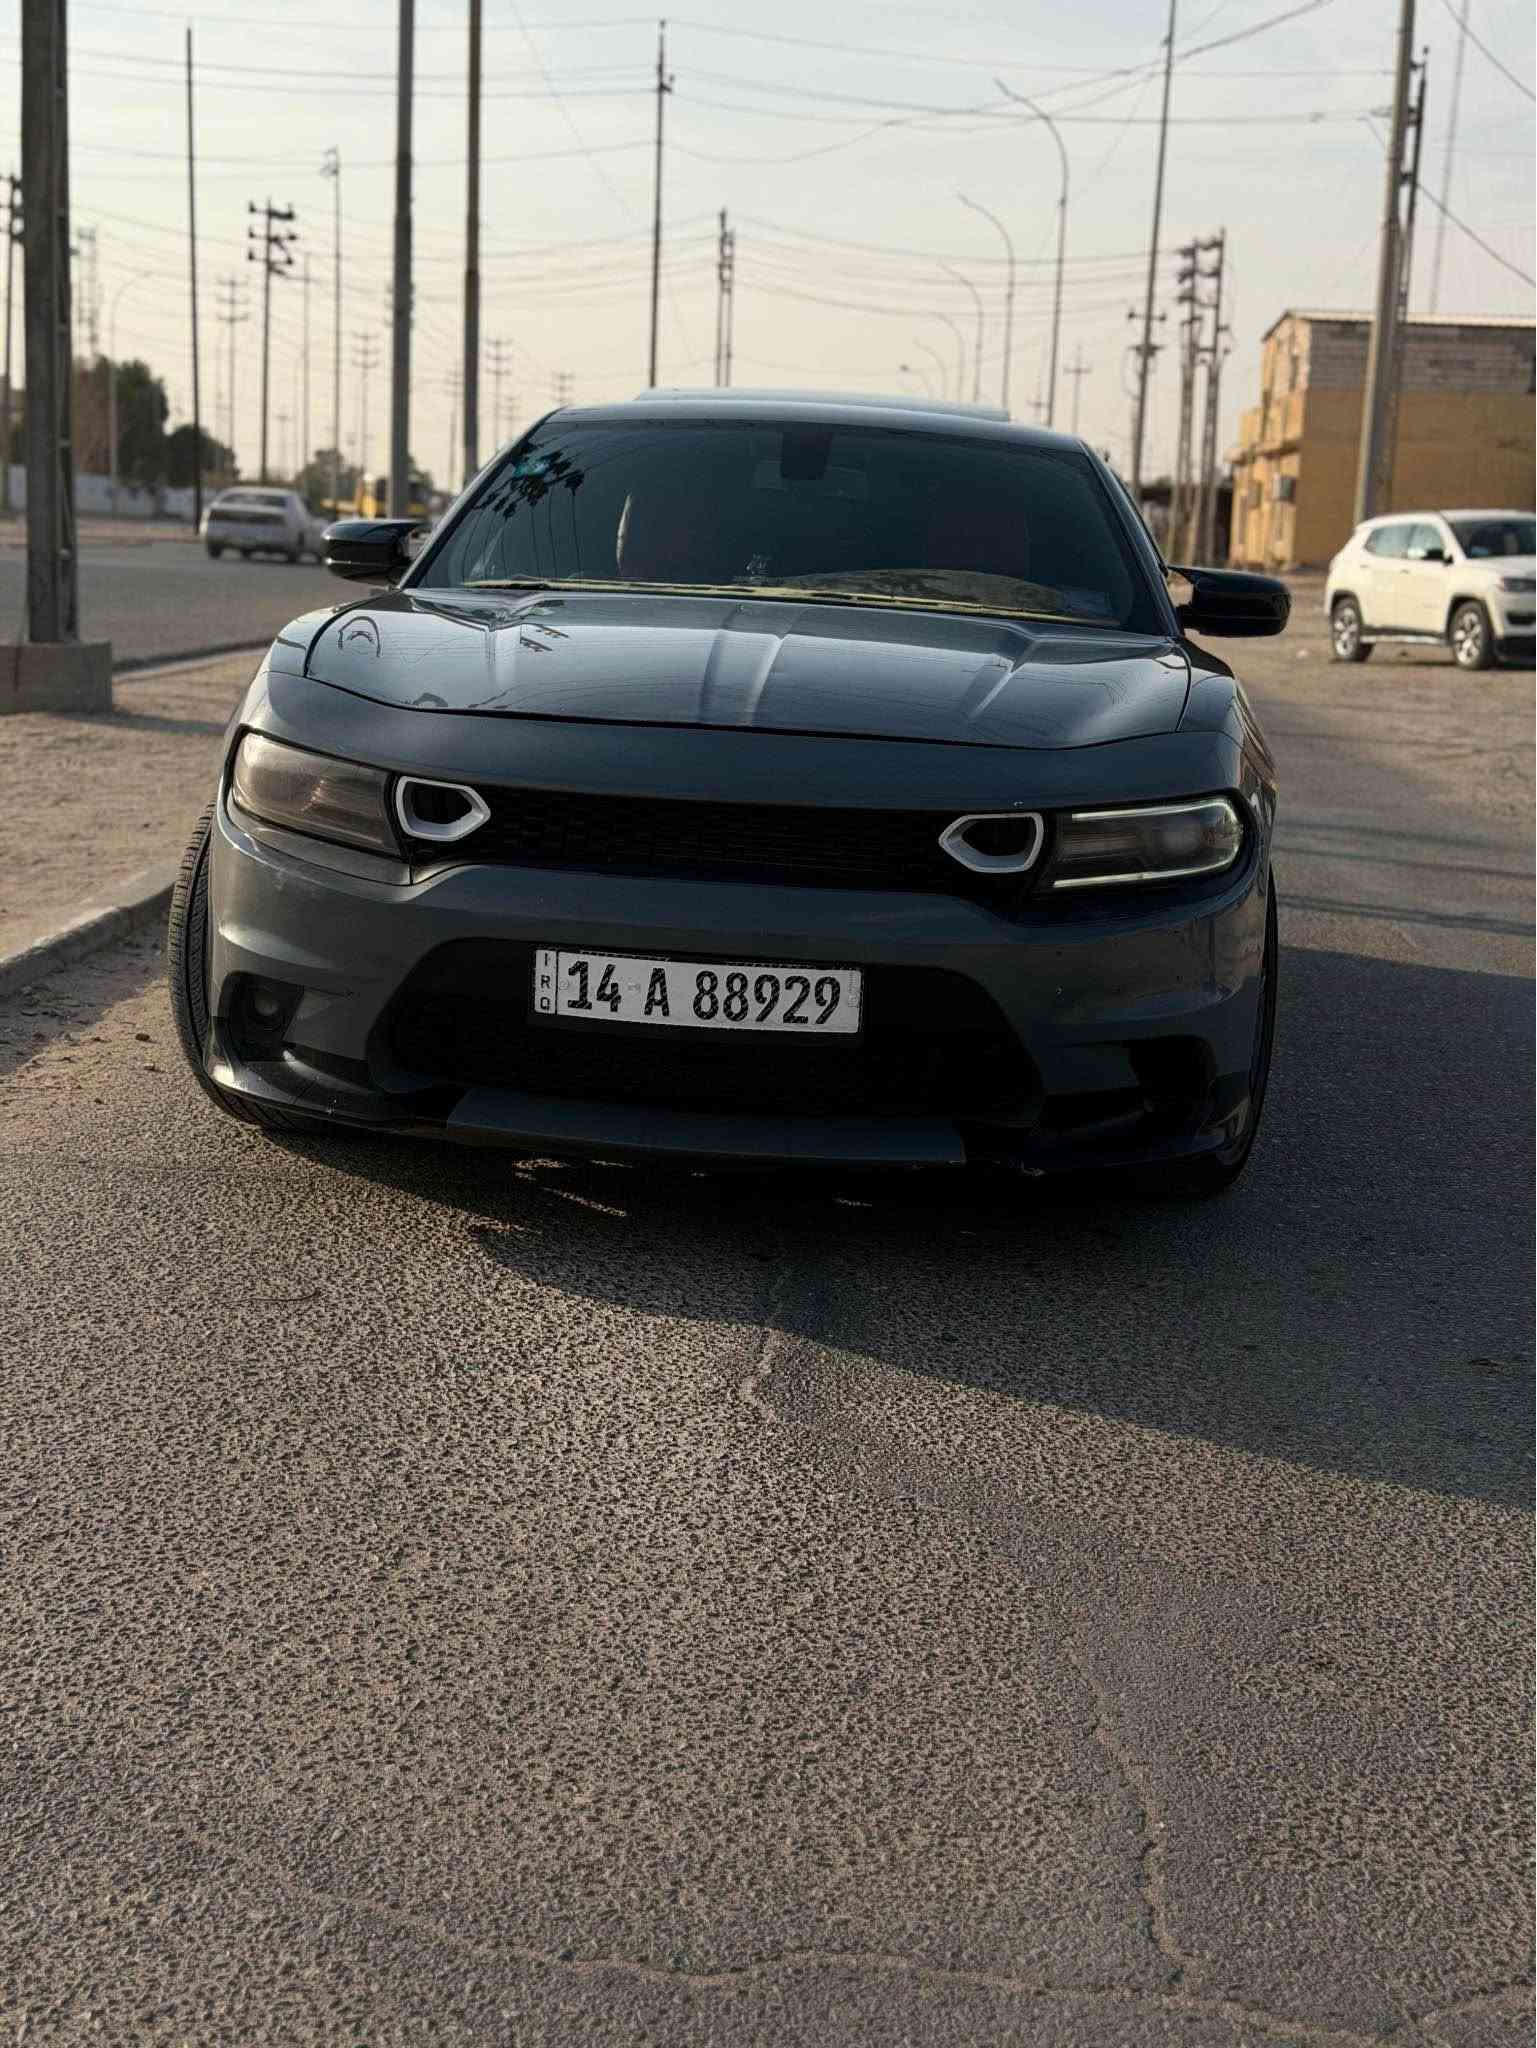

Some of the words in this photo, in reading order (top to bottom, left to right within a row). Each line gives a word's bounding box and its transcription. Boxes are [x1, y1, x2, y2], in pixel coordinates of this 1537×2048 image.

[567, 960, 622, 1012] 14
[644, 967, 670, 1017] A
[692, 970, 841, 1025] 88929
